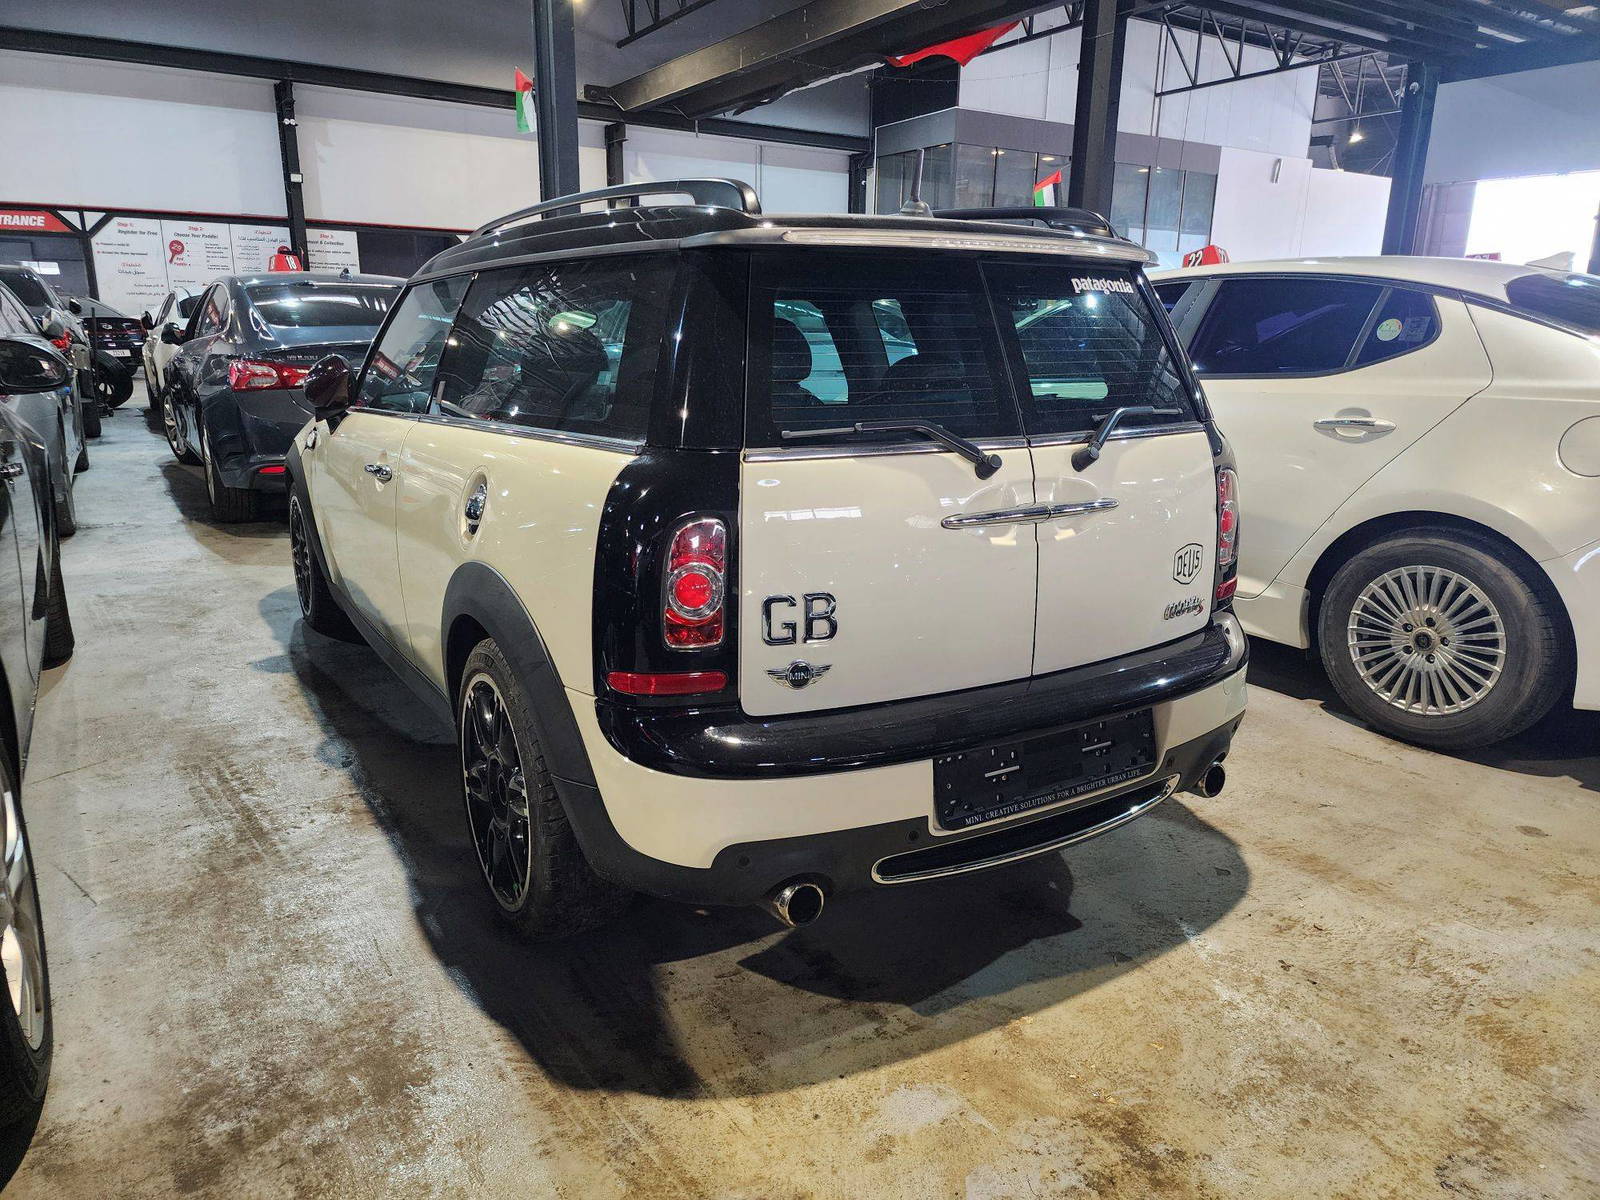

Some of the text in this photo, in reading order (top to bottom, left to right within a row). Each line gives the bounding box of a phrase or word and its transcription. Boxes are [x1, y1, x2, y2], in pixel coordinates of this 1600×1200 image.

[1189, 250, 1203, 268] 22
[1071, 276, 1134, 295] patagonia
[1176, 549, 1200, 577] DEUS
[762, 592, 838, 646] GB
[985, 804, 1019, 819] CREATIVE
[1020, 793, 1056, 810] SOLUTIONS
[1057, 791, 1070, 799] FOR
[1076, 779, 1106, 794] BRIGHTER
[1107, 773, 1127, 785] URBAN
